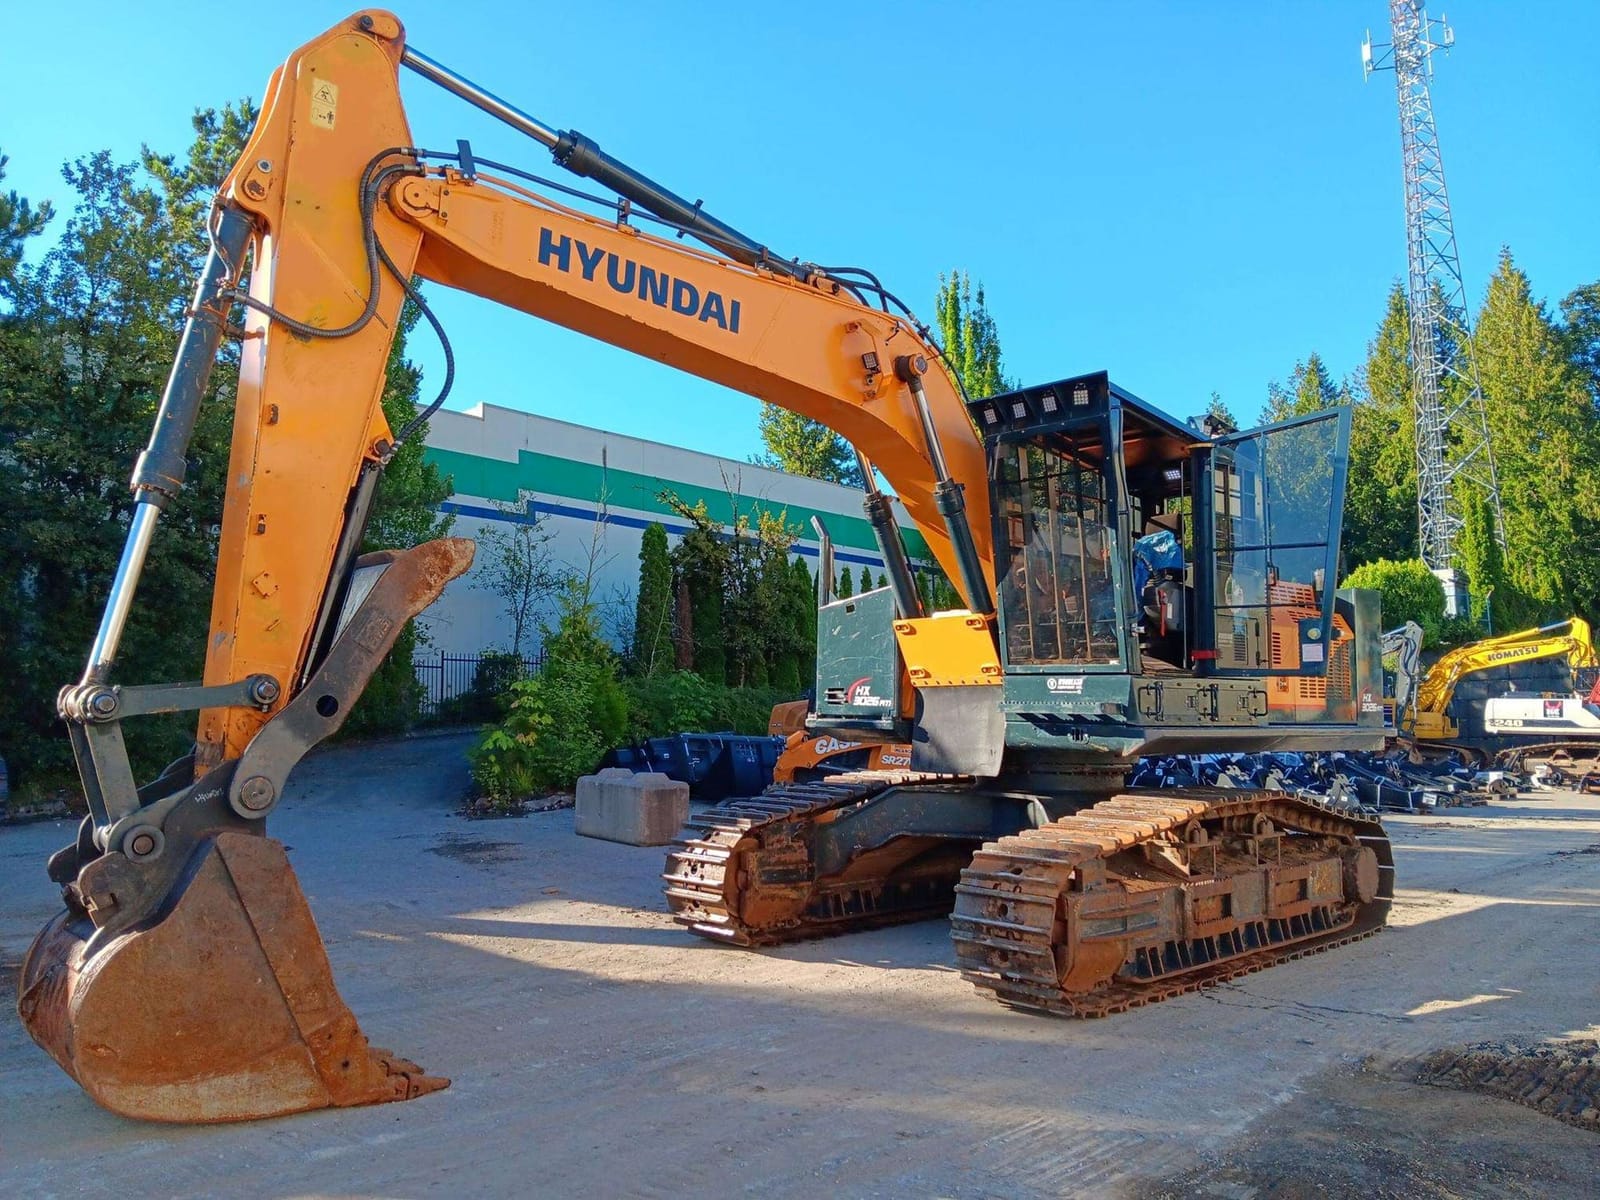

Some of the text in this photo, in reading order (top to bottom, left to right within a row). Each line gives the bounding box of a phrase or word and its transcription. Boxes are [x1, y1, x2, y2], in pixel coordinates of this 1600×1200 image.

[537, 227, 741, 334] HYUNDAI
[1487, 645, 1539, 662] KOMATSU
[855, 685, 871, 696] HX
[815, 738, 862, 754] CA
[882, 755, 911, 766] SR27
